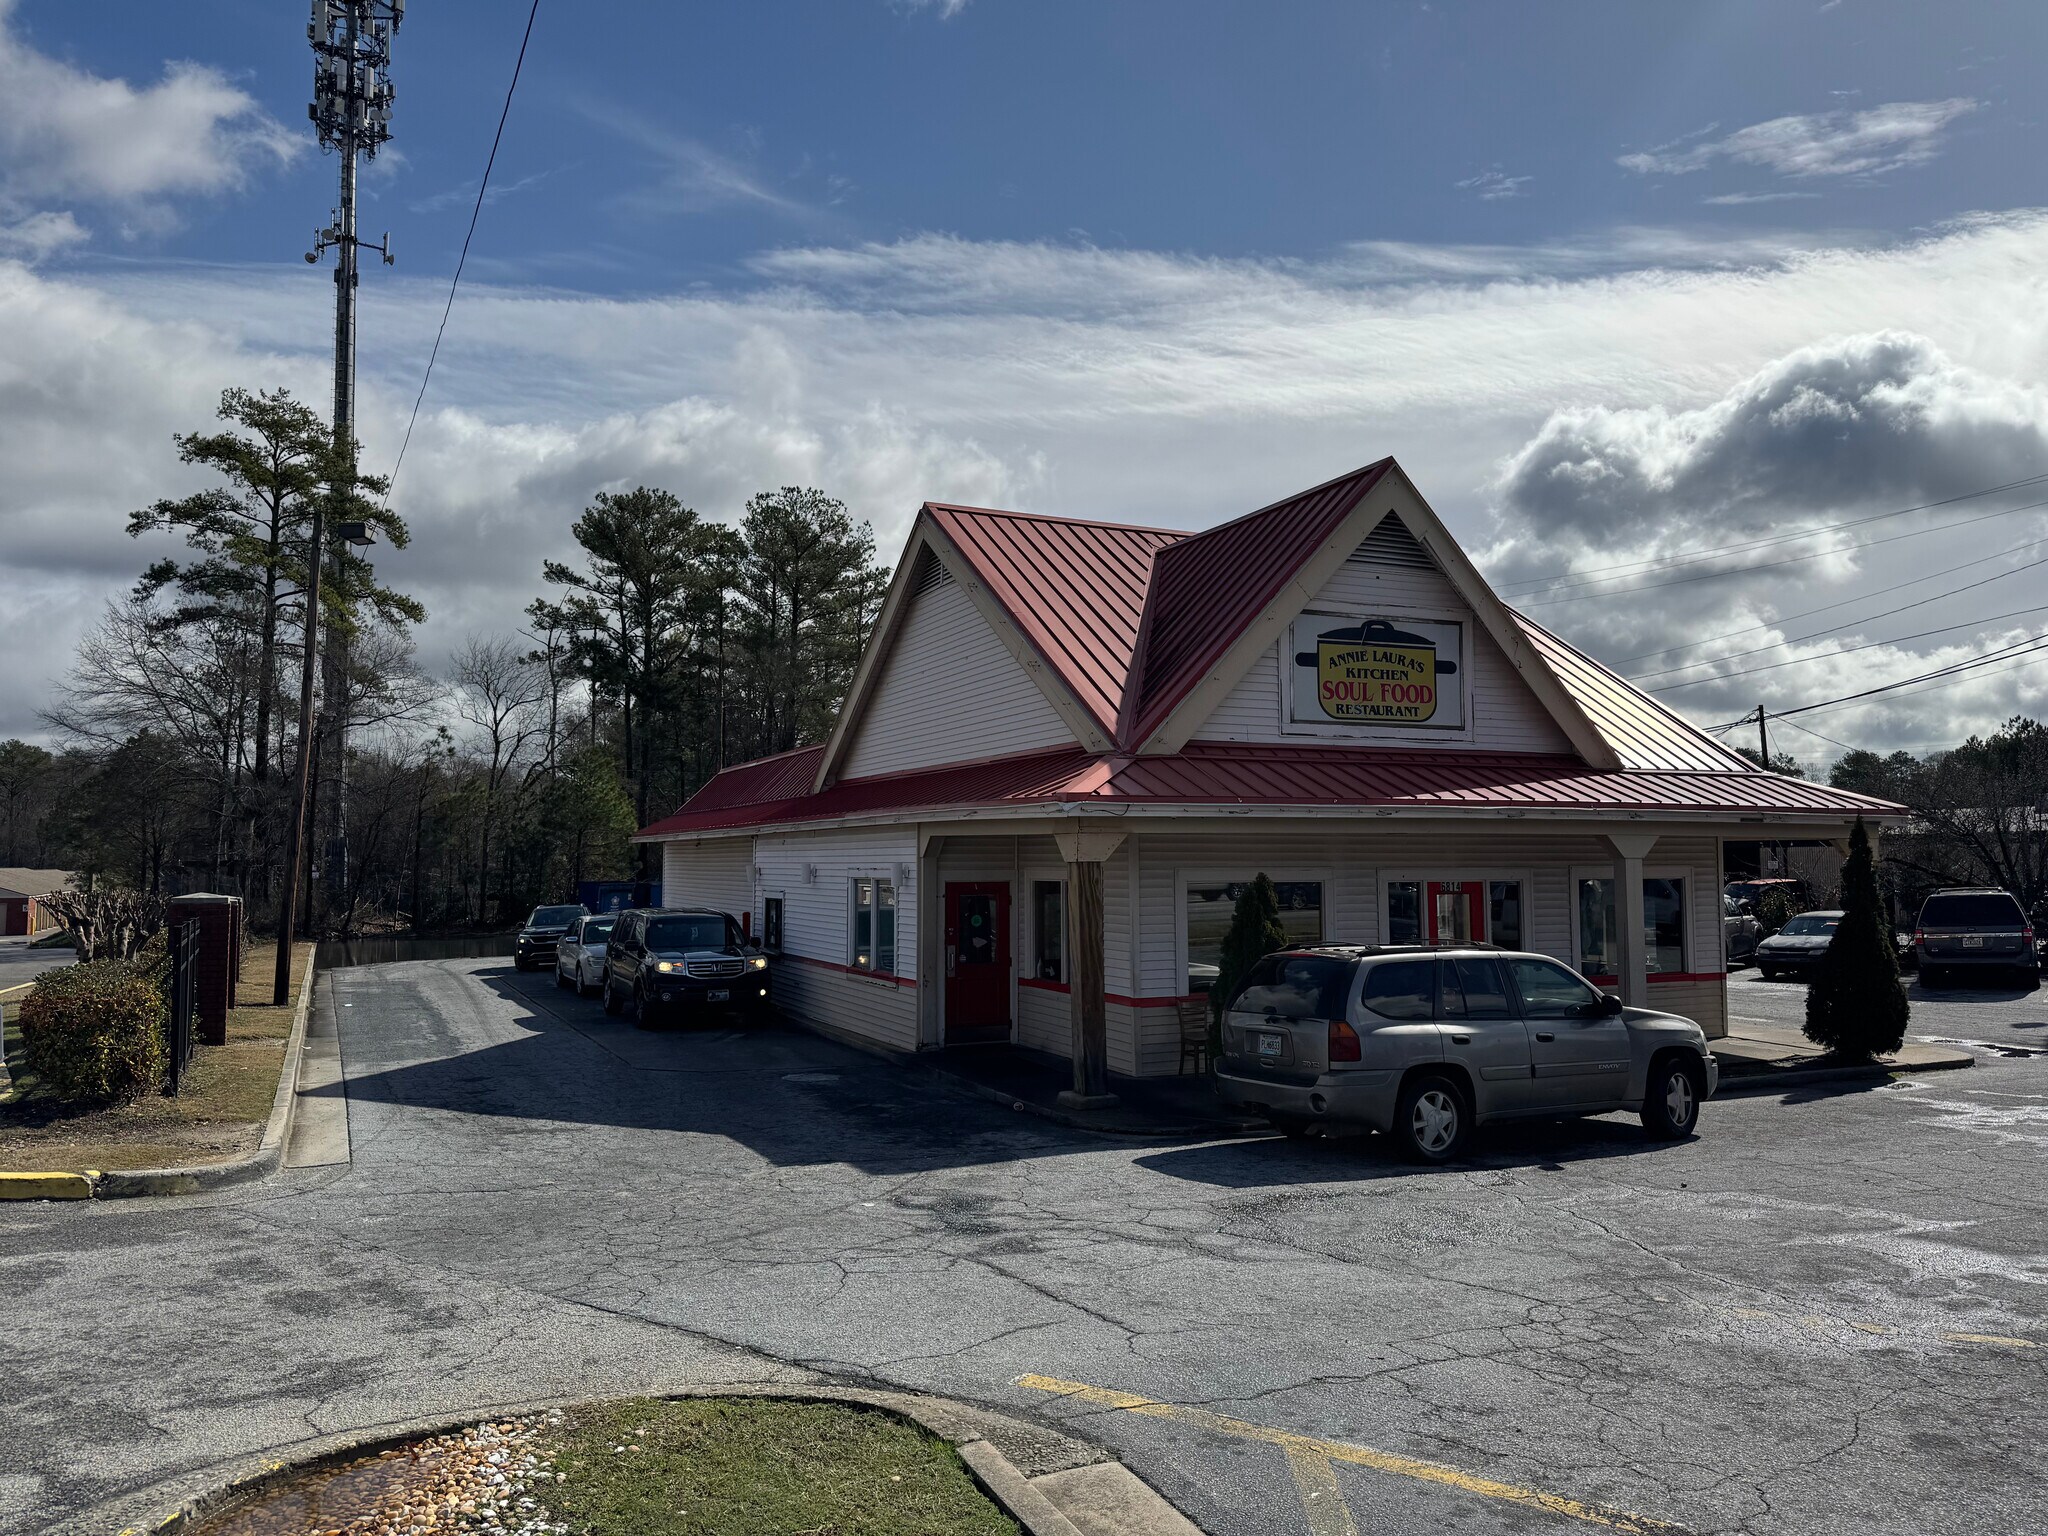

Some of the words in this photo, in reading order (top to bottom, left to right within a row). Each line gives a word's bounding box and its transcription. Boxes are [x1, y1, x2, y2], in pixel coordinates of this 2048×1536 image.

[1329, 650, 1368, 669] ANNIE
[1373, 650, 1425, 673] LAURA'S
[1346, 668, 1409, 681] KITCHEN
[1322, 680, 1374, 702] SOUL
[1380, 683, 1433, 704] FOOD
[1335, 704, 1420, 717] RESTAURANT
[1441, 881, 1461, 892] 6814
